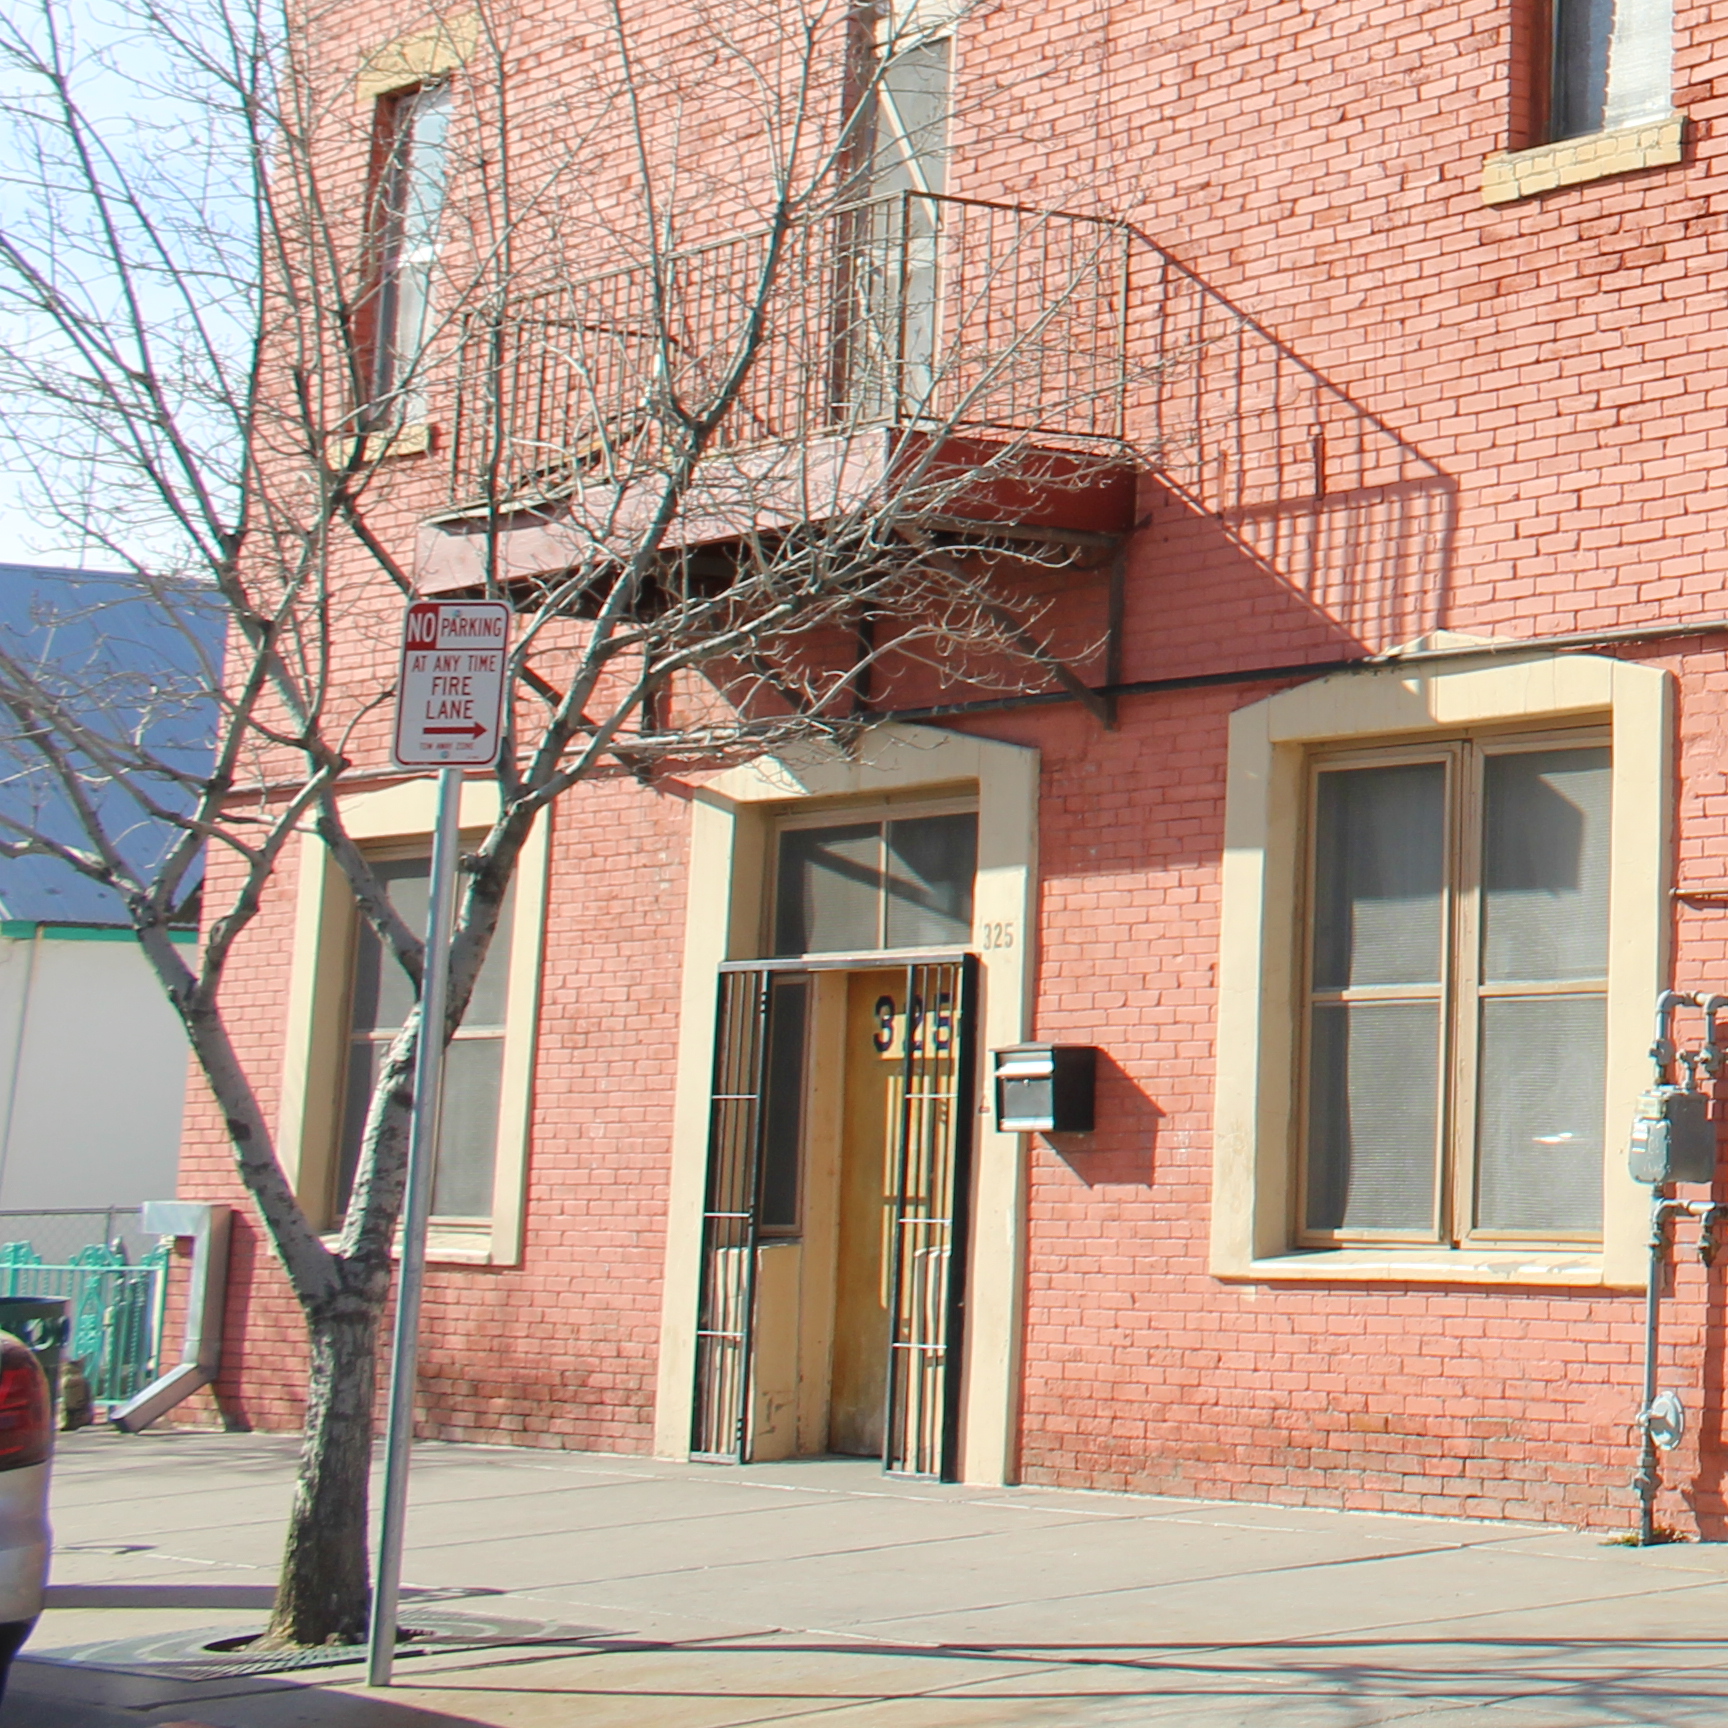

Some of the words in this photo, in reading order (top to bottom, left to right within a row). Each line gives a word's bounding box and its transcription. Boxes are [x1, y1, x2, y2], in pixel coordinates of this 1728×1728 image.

[407, 612, 437, 643] NO
[441, 616, 503, 638] PARKING
[412, 655, 428, 673] AT
[433, 654, 461, 673] ANY
[468, 654, 497, 672] TIME
[431, 676, 473, 696] FIRE
[426, 699, 475, 720] LANE
[982, 921, 1014, 950] 325
